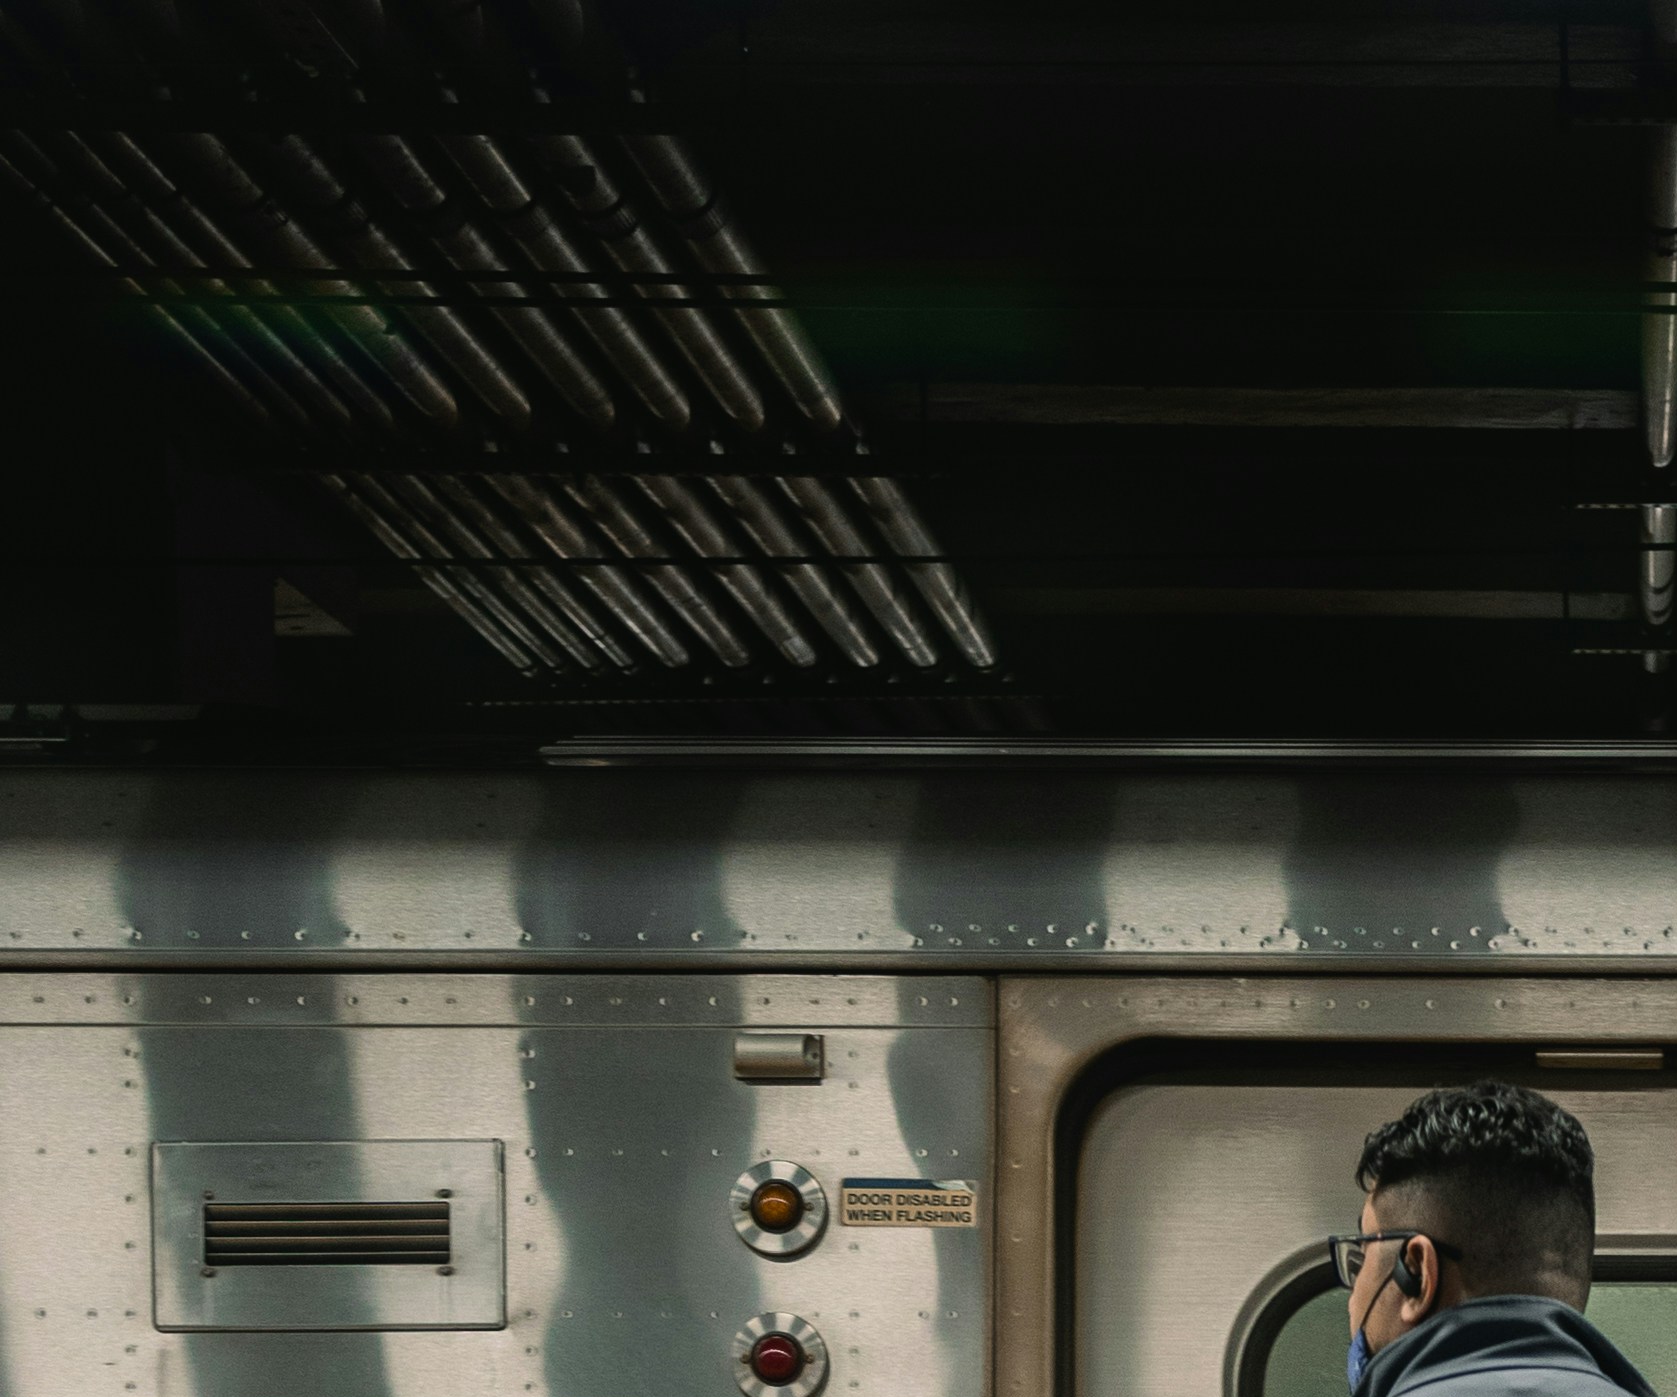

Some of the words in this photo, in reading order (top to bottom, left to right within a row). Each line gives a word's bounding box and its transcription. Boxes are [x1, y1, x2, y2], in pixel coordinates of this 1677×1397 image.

[847, 1193, 892, 1206] DOOR
[896, 1193, 972, 1207] DISABLED
[846, 1209, 892, 1221] WHEN
[896, 1210, 972, 1223] FLASHING
